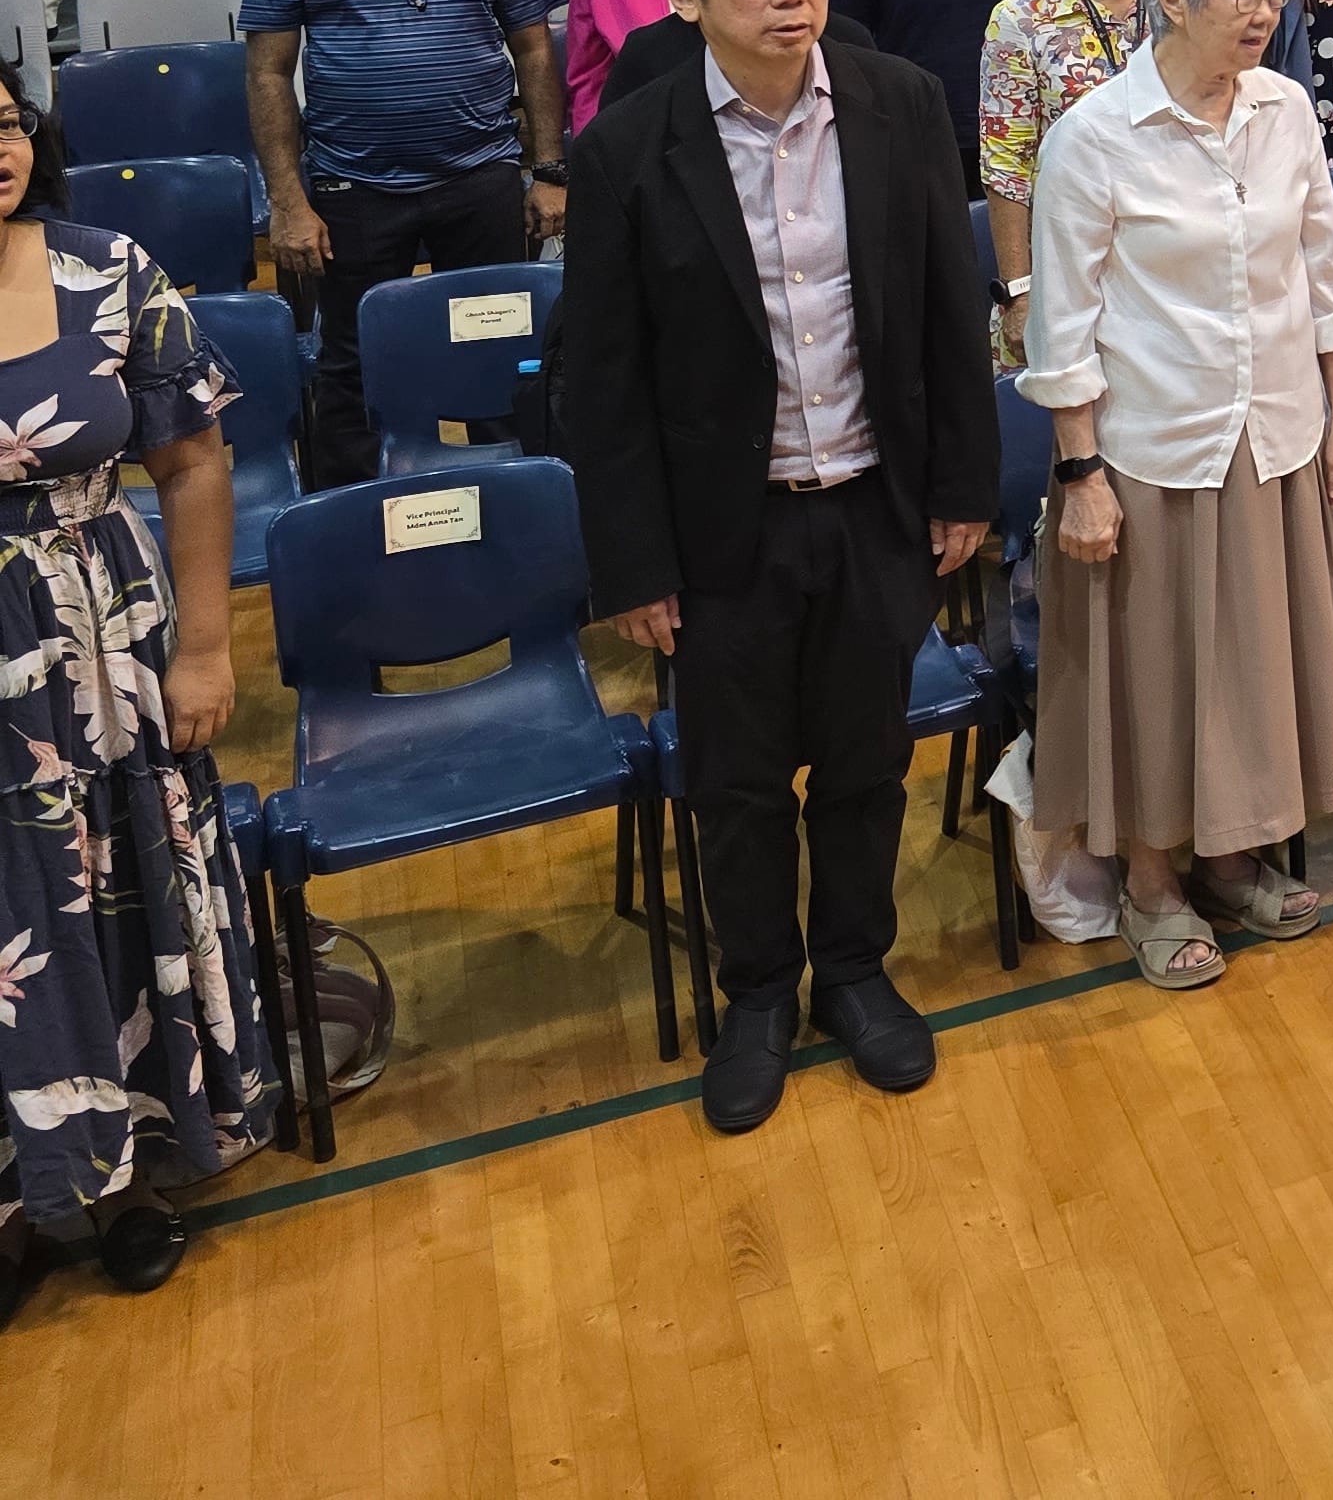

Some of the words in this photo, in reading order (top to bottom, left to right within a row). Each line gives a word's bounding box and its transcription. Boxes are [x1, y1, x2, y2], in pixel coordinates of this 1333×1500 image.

[405, 513, 424, 521] Vice
[424, 506, 460, 519] Principal
[406, 522, 427, 530] Mdm
[427, 519, 449, 528] Anna
